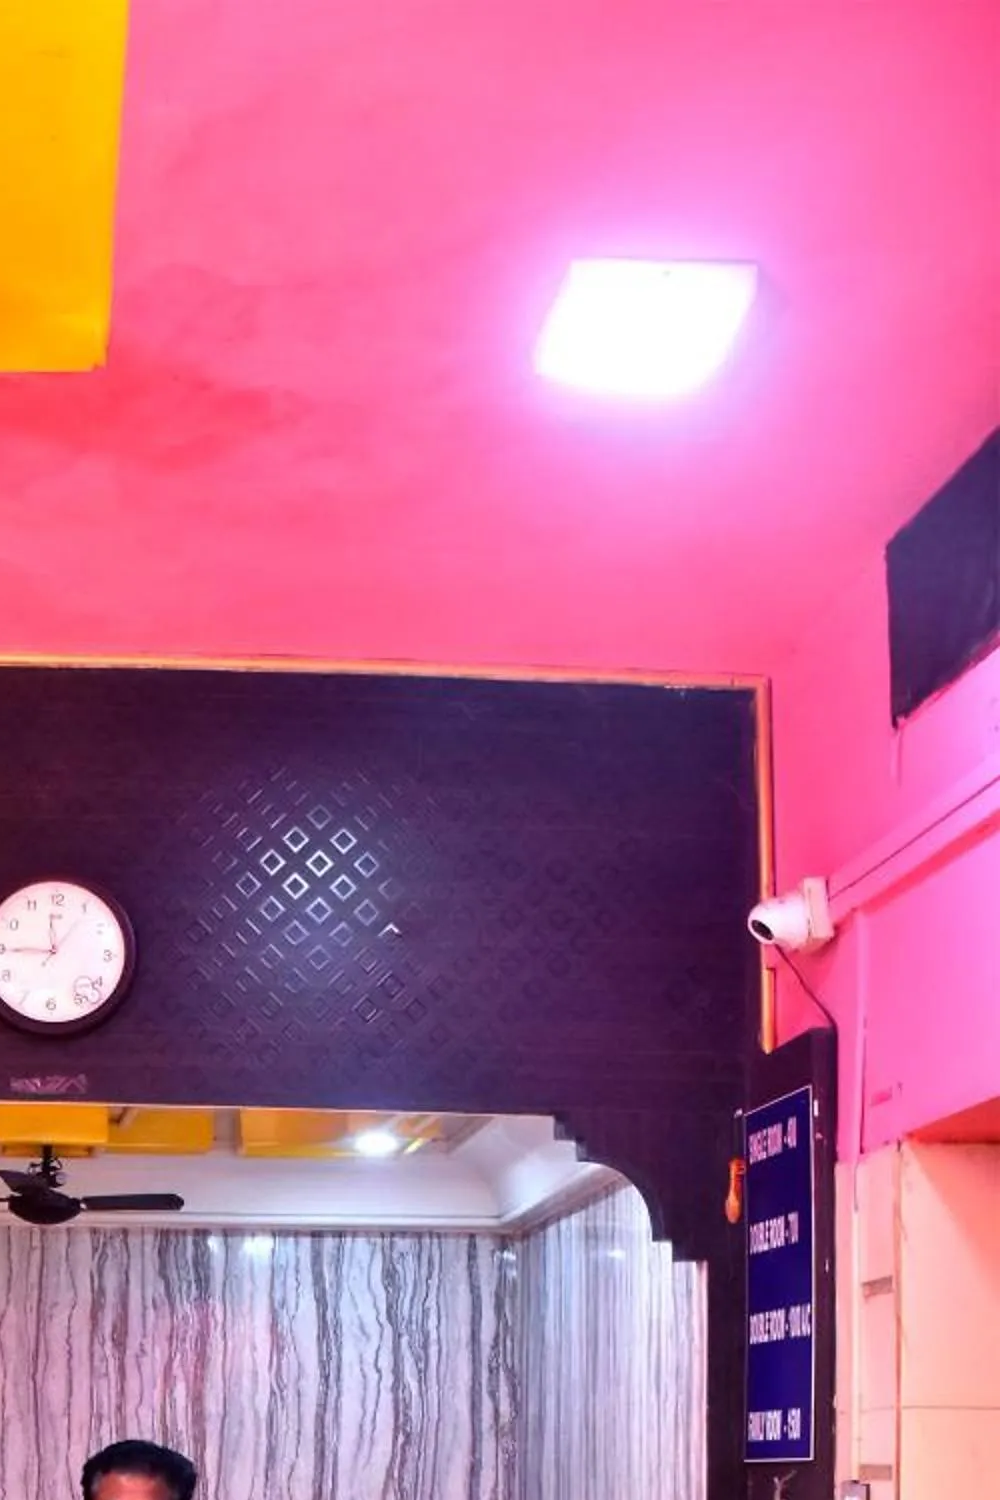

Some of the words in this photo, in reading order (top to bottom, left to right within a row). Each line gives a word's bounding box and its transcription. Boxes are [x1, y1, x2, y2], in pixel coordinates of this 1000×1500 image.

[27, 899, 38, 911] 11
[50, 893, 65, 906] 12
[103, 949, 113, 962] 3
[45, 998, 57, 1011] 6
